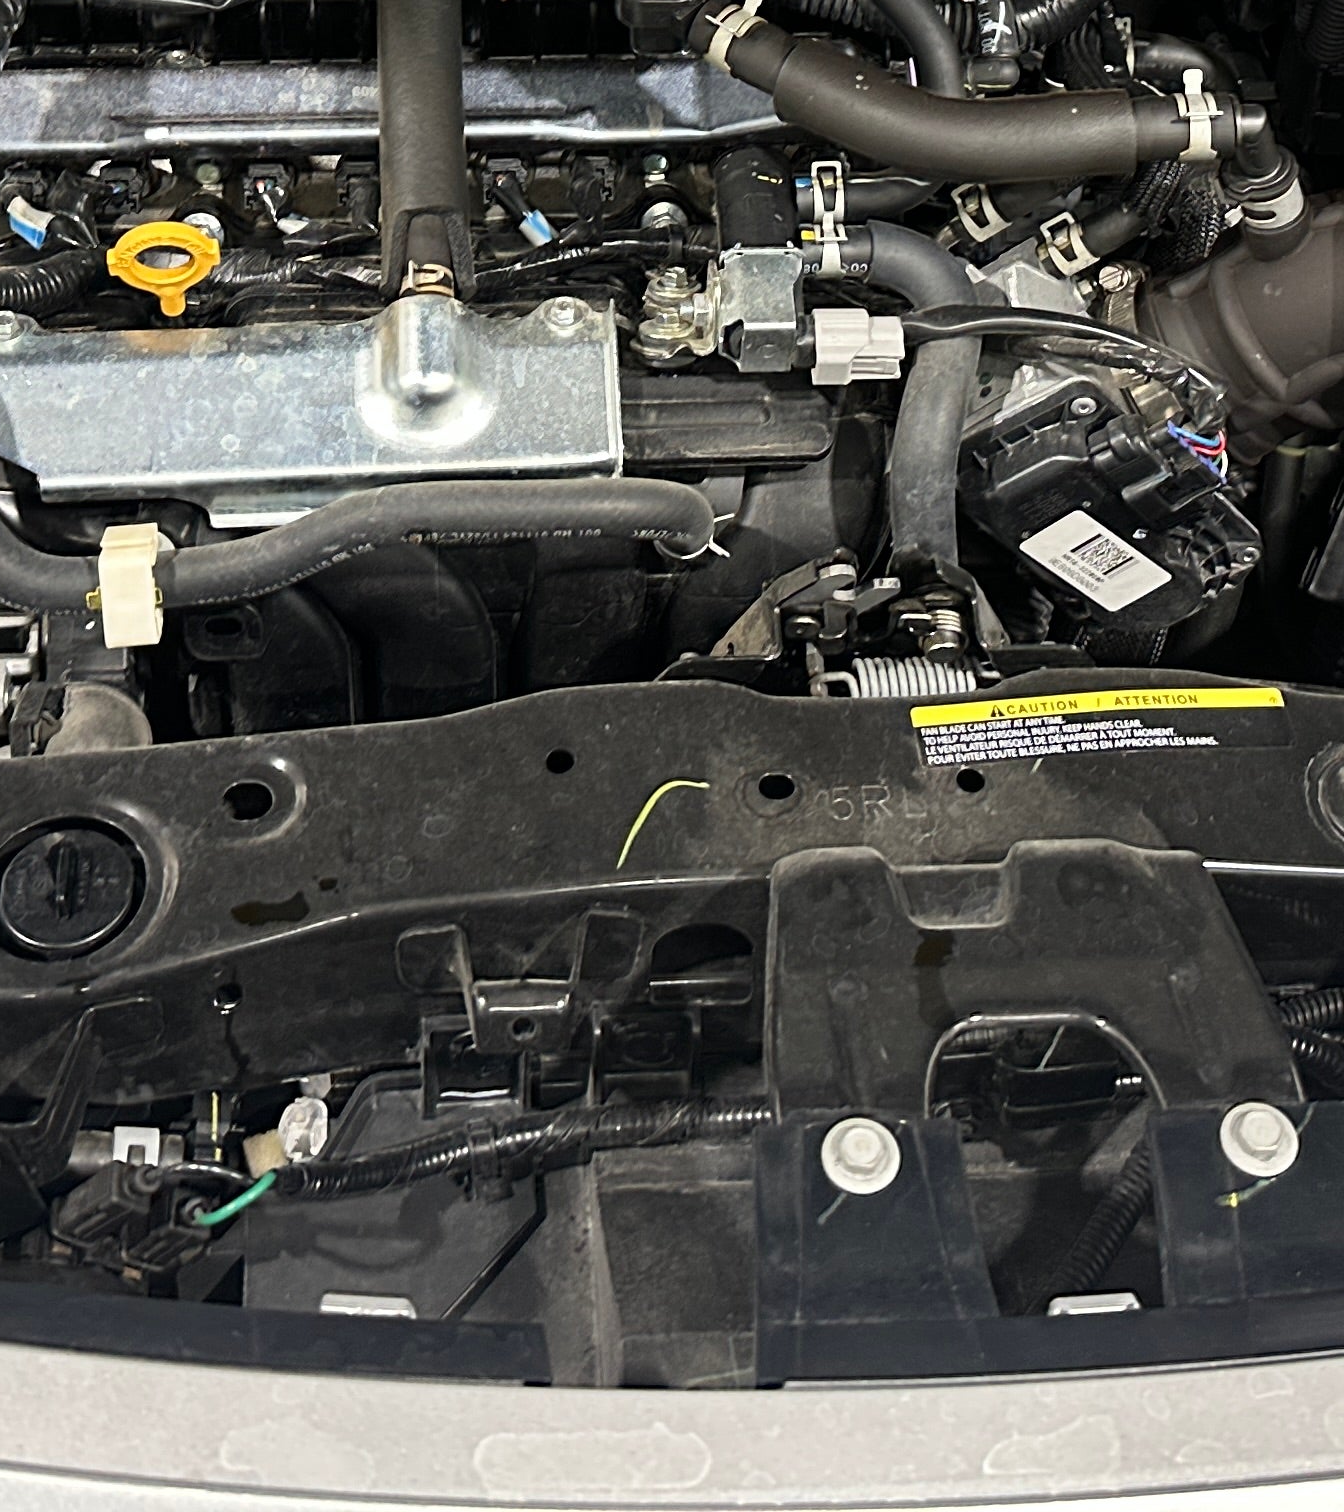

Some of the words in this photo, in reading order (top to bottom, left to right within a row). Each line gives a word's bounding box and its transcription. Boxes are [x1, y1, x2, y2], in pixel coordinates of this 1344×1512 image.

[980, 37, 995, 54] DO
[1006, 699, 1079, 715] CAUTION
[1113, 693, 1199, 706] ATTENTION
[921, 727, 939, 737] FAN
[939, 724, 966, 735] BLADE
[967, 722, 986, 733] CAN
[987, 719, 1011, 730] START
[1014, 718, 1025, 728] AT
[924, 737, 936, 746] TO
[937, 734, 959, 744] HELP
[959, 731, 986, 742] AVOID
[987, 728, 1030, 740] PERSONAL
[1062, 723, 1083, 733] KEEP
[1083, 720, 1114, 731] HANDS
[1114, 719, 1143, 728] CLEAR.
[925, 747, 936, 755] LE
[937, 740, 998, 754] VENTILATEUR
[999, 736, 1032, 748] RISQUE
[1034, 735, 1047, 745] DE
[1048, 731, 1098, 744] DÉMARRER
[1099, 728, 1107, 739] À
[1107, 728, 1132, 739] TOUT
[1133, 727, 1177, 738] MOMENT.
[927, 755, 955, 766] POUR
[955, 751, 987, 763] ÉVITER
[987, 748, 1018, 760] TOUTE
[1018, 744, 1067, 757] BLESSURE,
[1067, 743, 1081, 752] NE
[1081, 741, 1099, 751] PAS
[1099, 740, 1113, 749] EN
[1114, 736, 1169, 749] APPROCHER
[1169, 736, 1186, 746] LES
[1186, 736, 1219, 746] MAINS.
